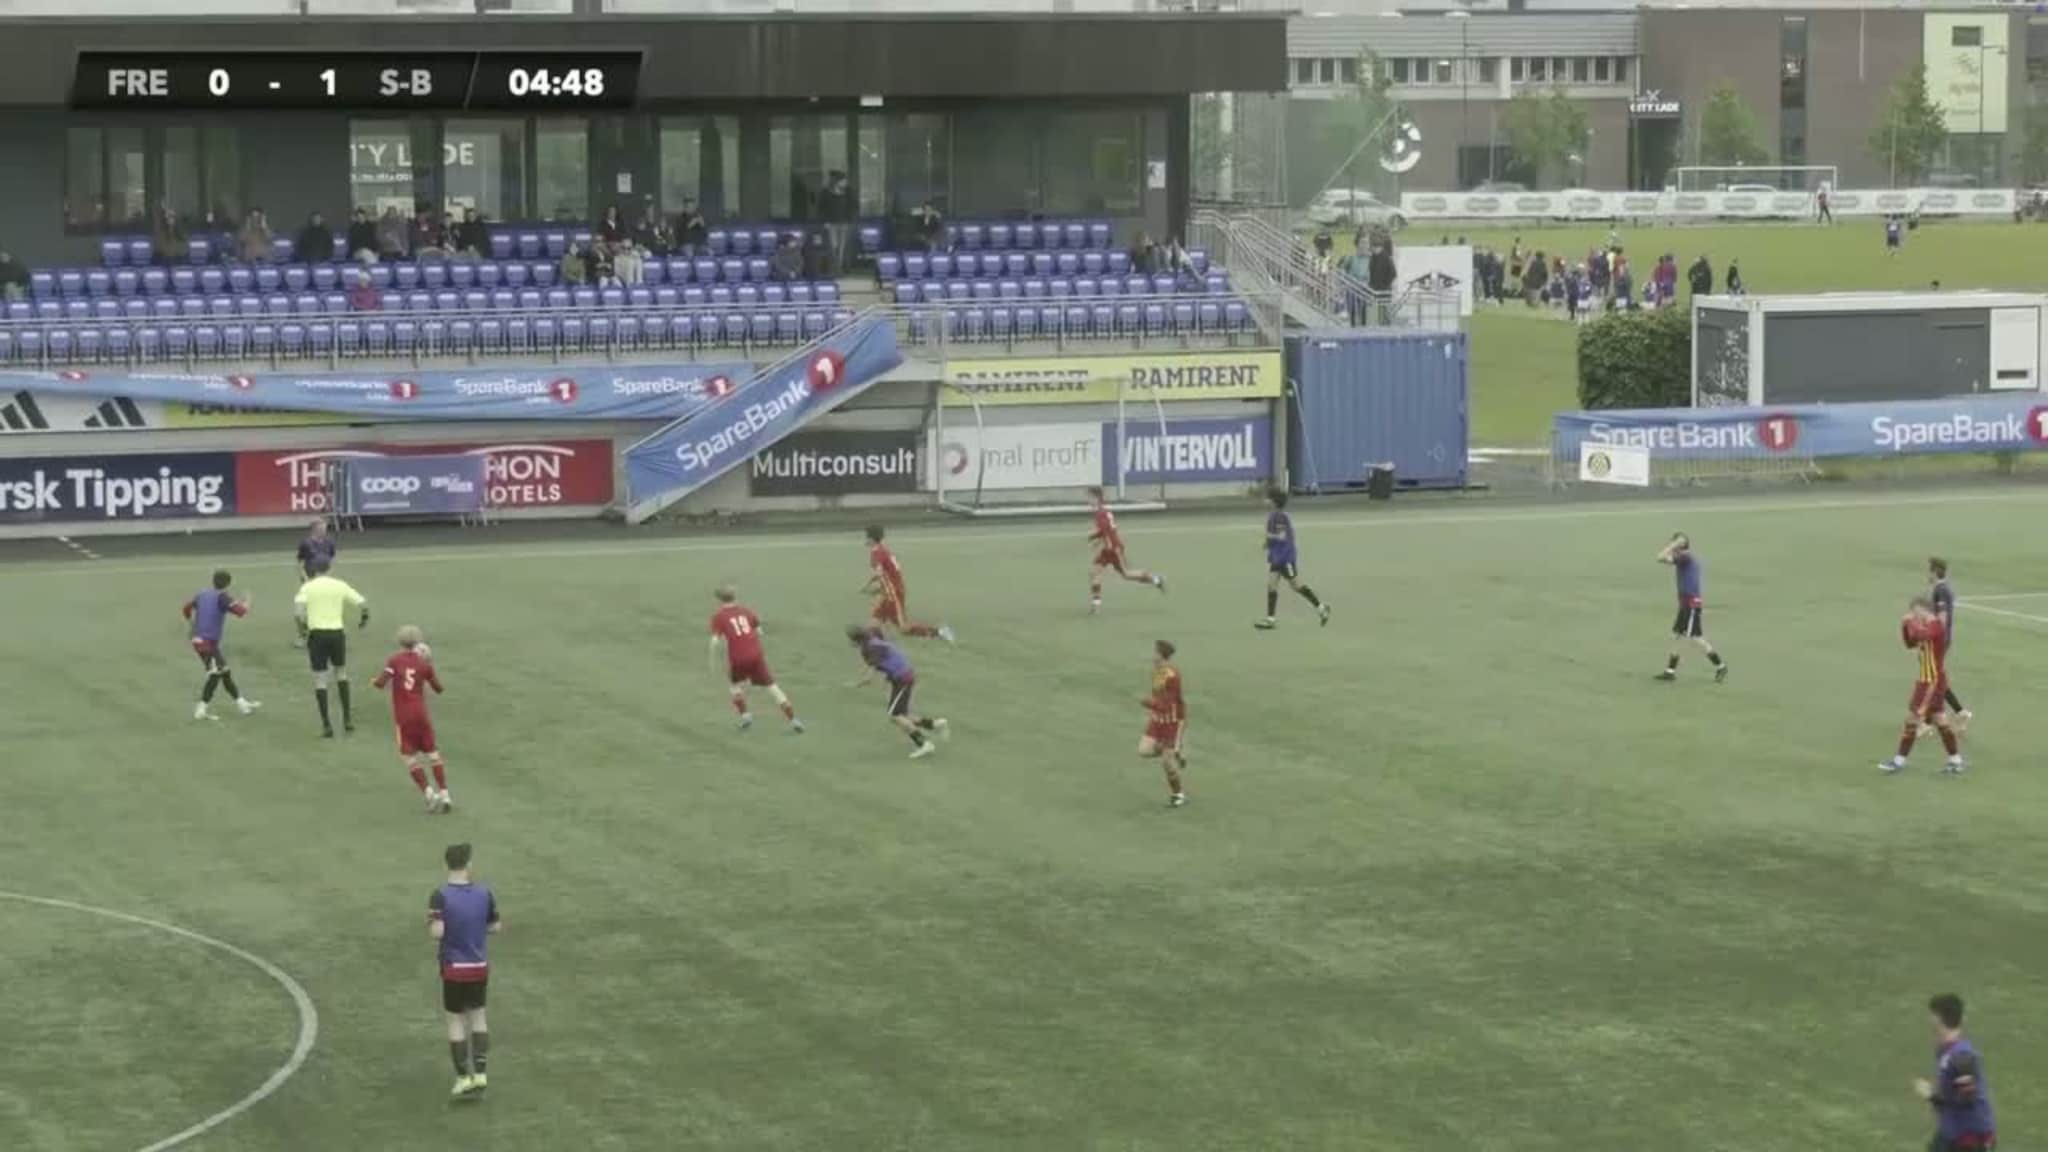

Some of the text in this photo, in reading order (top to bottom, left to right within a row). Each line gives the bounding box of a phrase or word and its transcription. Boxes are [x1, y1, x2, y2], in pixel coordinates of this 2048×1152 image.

[454, 378, 549, 395] SpareBank
[612, 377, 707, 395] SpareBank
[1130, 364, 1260, 390] RAMIRENT
[676, 356, 834, 471] SpareBank 1
[1768, 419, 1785, 446] 1
[1872, 413, 2024, 450] SpareBank
[484, 455, 560, 480] HON
[751, 448, 915, 478] Multiconsult
[66, 466, 224, 517] Tipping
[361, 476, 421, 495] coop
[404, 668, 416, 690] 5
